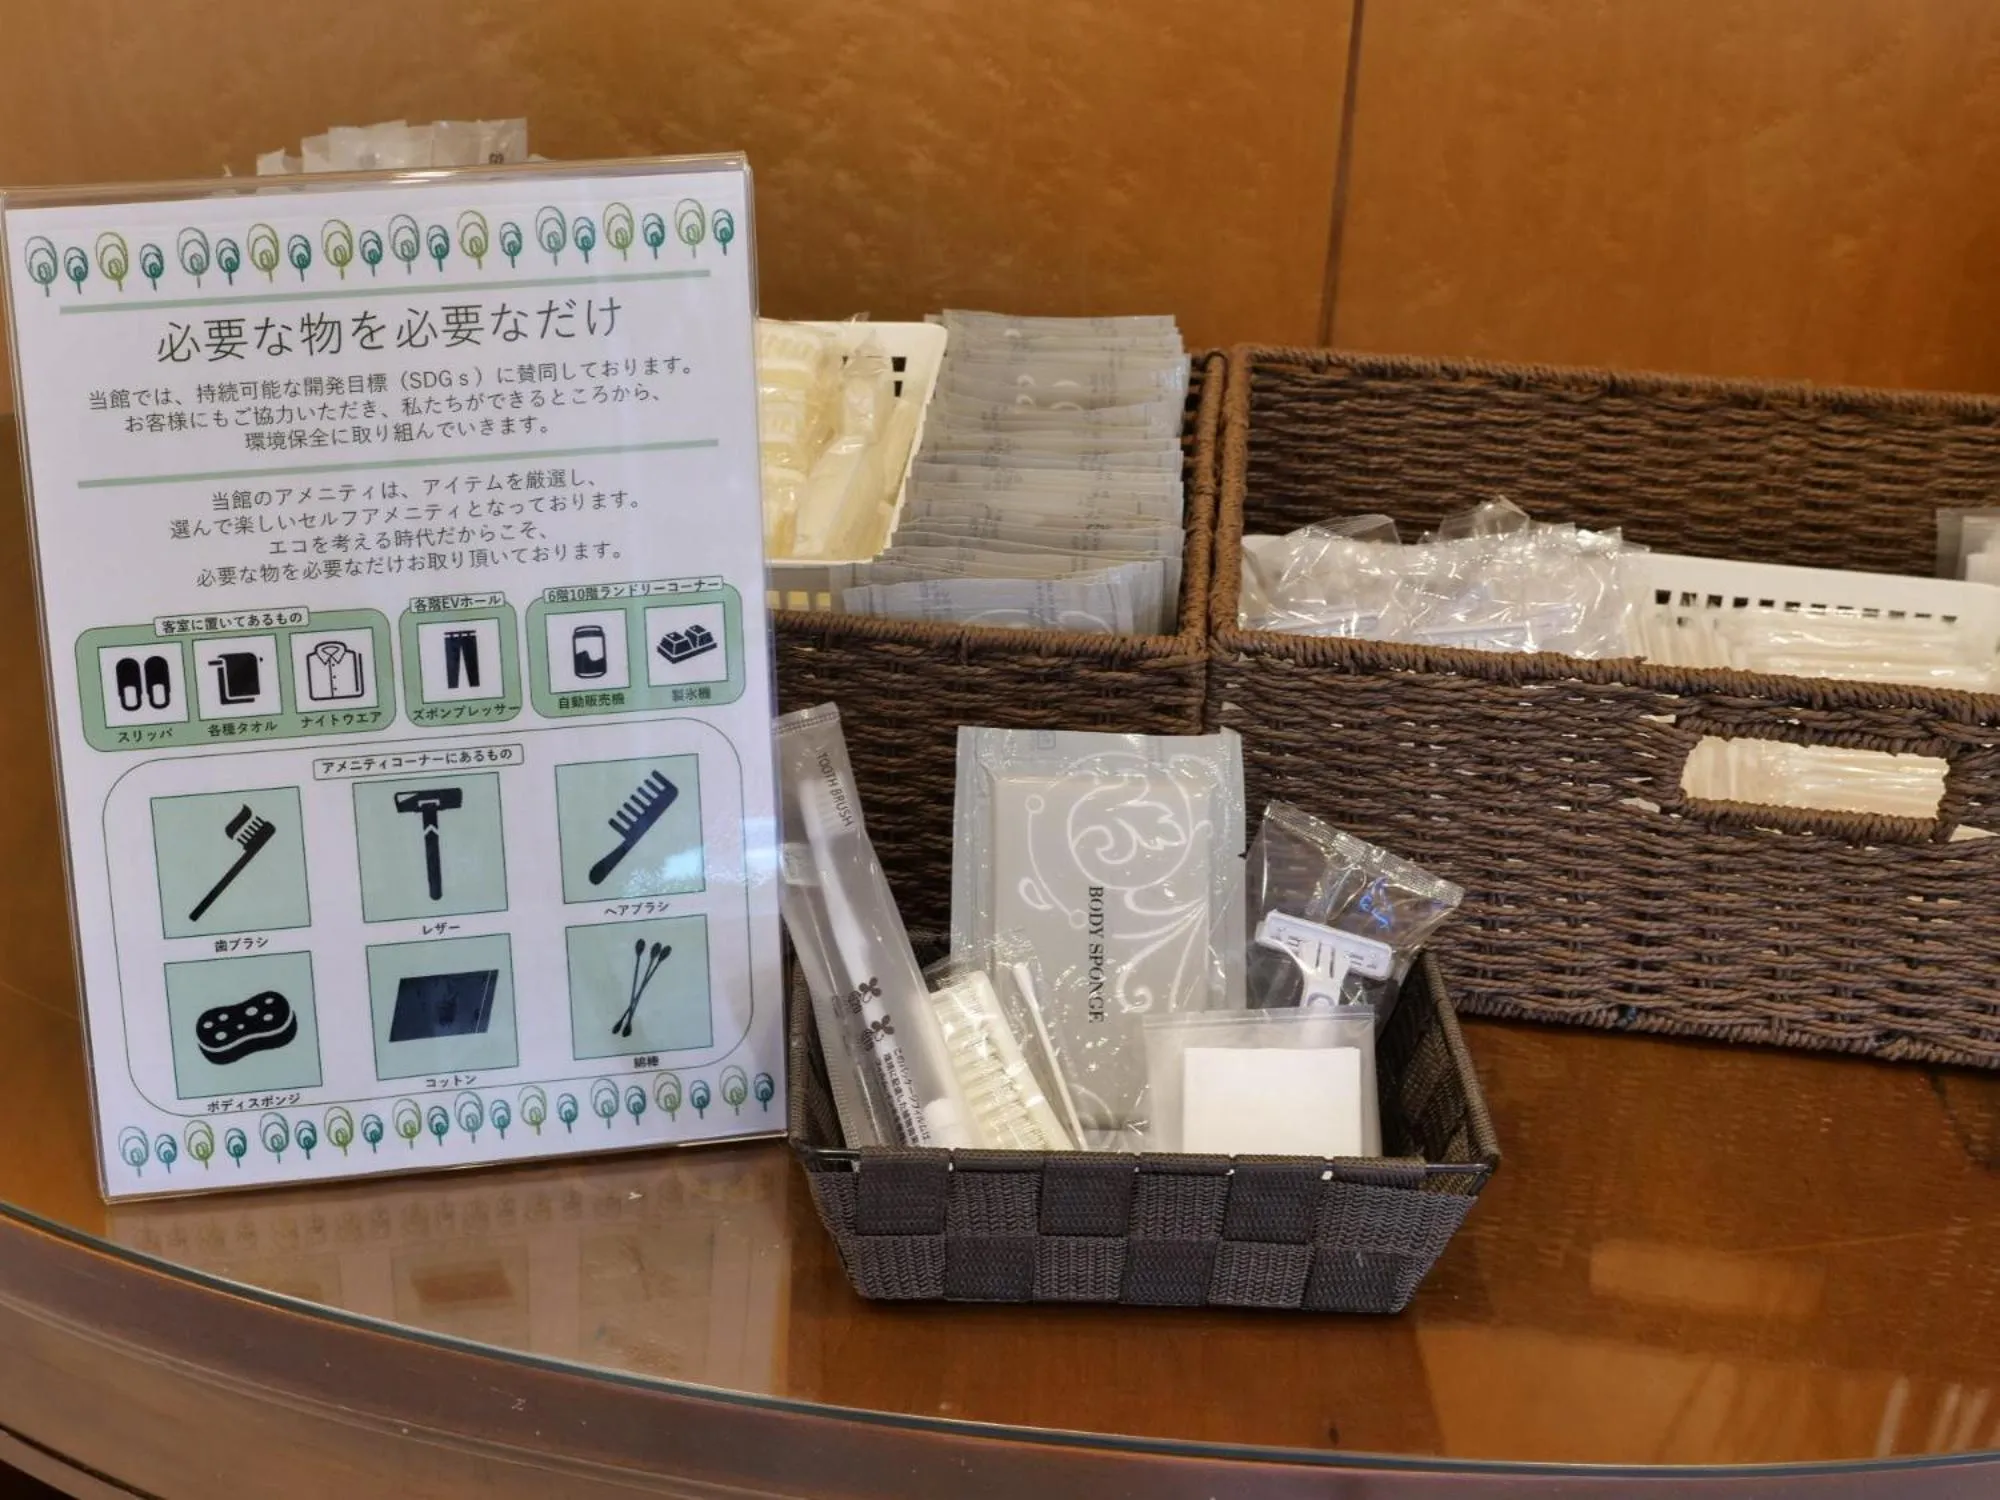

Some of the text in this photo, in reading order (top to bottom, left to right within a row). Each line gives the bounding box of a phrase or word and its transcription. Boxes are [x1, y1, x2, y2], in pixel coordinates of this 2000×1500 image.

[157, 296, 622, 363] 必要な物を必要なだけ
[124, 382, 660, 433] お客様にもご協力いただき、私たちができるところから、
[245, 414, 548, 451] 環境保全に取り組んでいきます。
[212, 468, 595, 511] 当館のアメニティは、アイテムを厳選し、
[170, 490, 639, 540] 選んで楽しいセルフアメニティとなっております。
[269, 520, 547, 555] エコを考える時代だからこそ、
[196, 541, 622, 587] 必要な物を必要なだけお取り頂いております。
[413, 593, 501, 612] 各階EVホール
[548, 578, 719, 602] 6階10階ランドリーコーナー
[162, 612, 303, 634] 客室に置いてあるもの
[117, 727, 173, 743] スリッパ
[208, 721, 278, 737] 各種タオル
[321, 748, 513, 774] アメニティコーナーにあるもの
[830, 788, 855, 828] BRUSH
[422, 921, 461, 935] レザー
[214, 937, 269, 953] 歯ブラシ
[1088, 886, 1105, 1024] BODY SPONGE
[425, 1074, 477, 1088] コットン
[207, 1092, 300, 1113] ボディスポンジ
